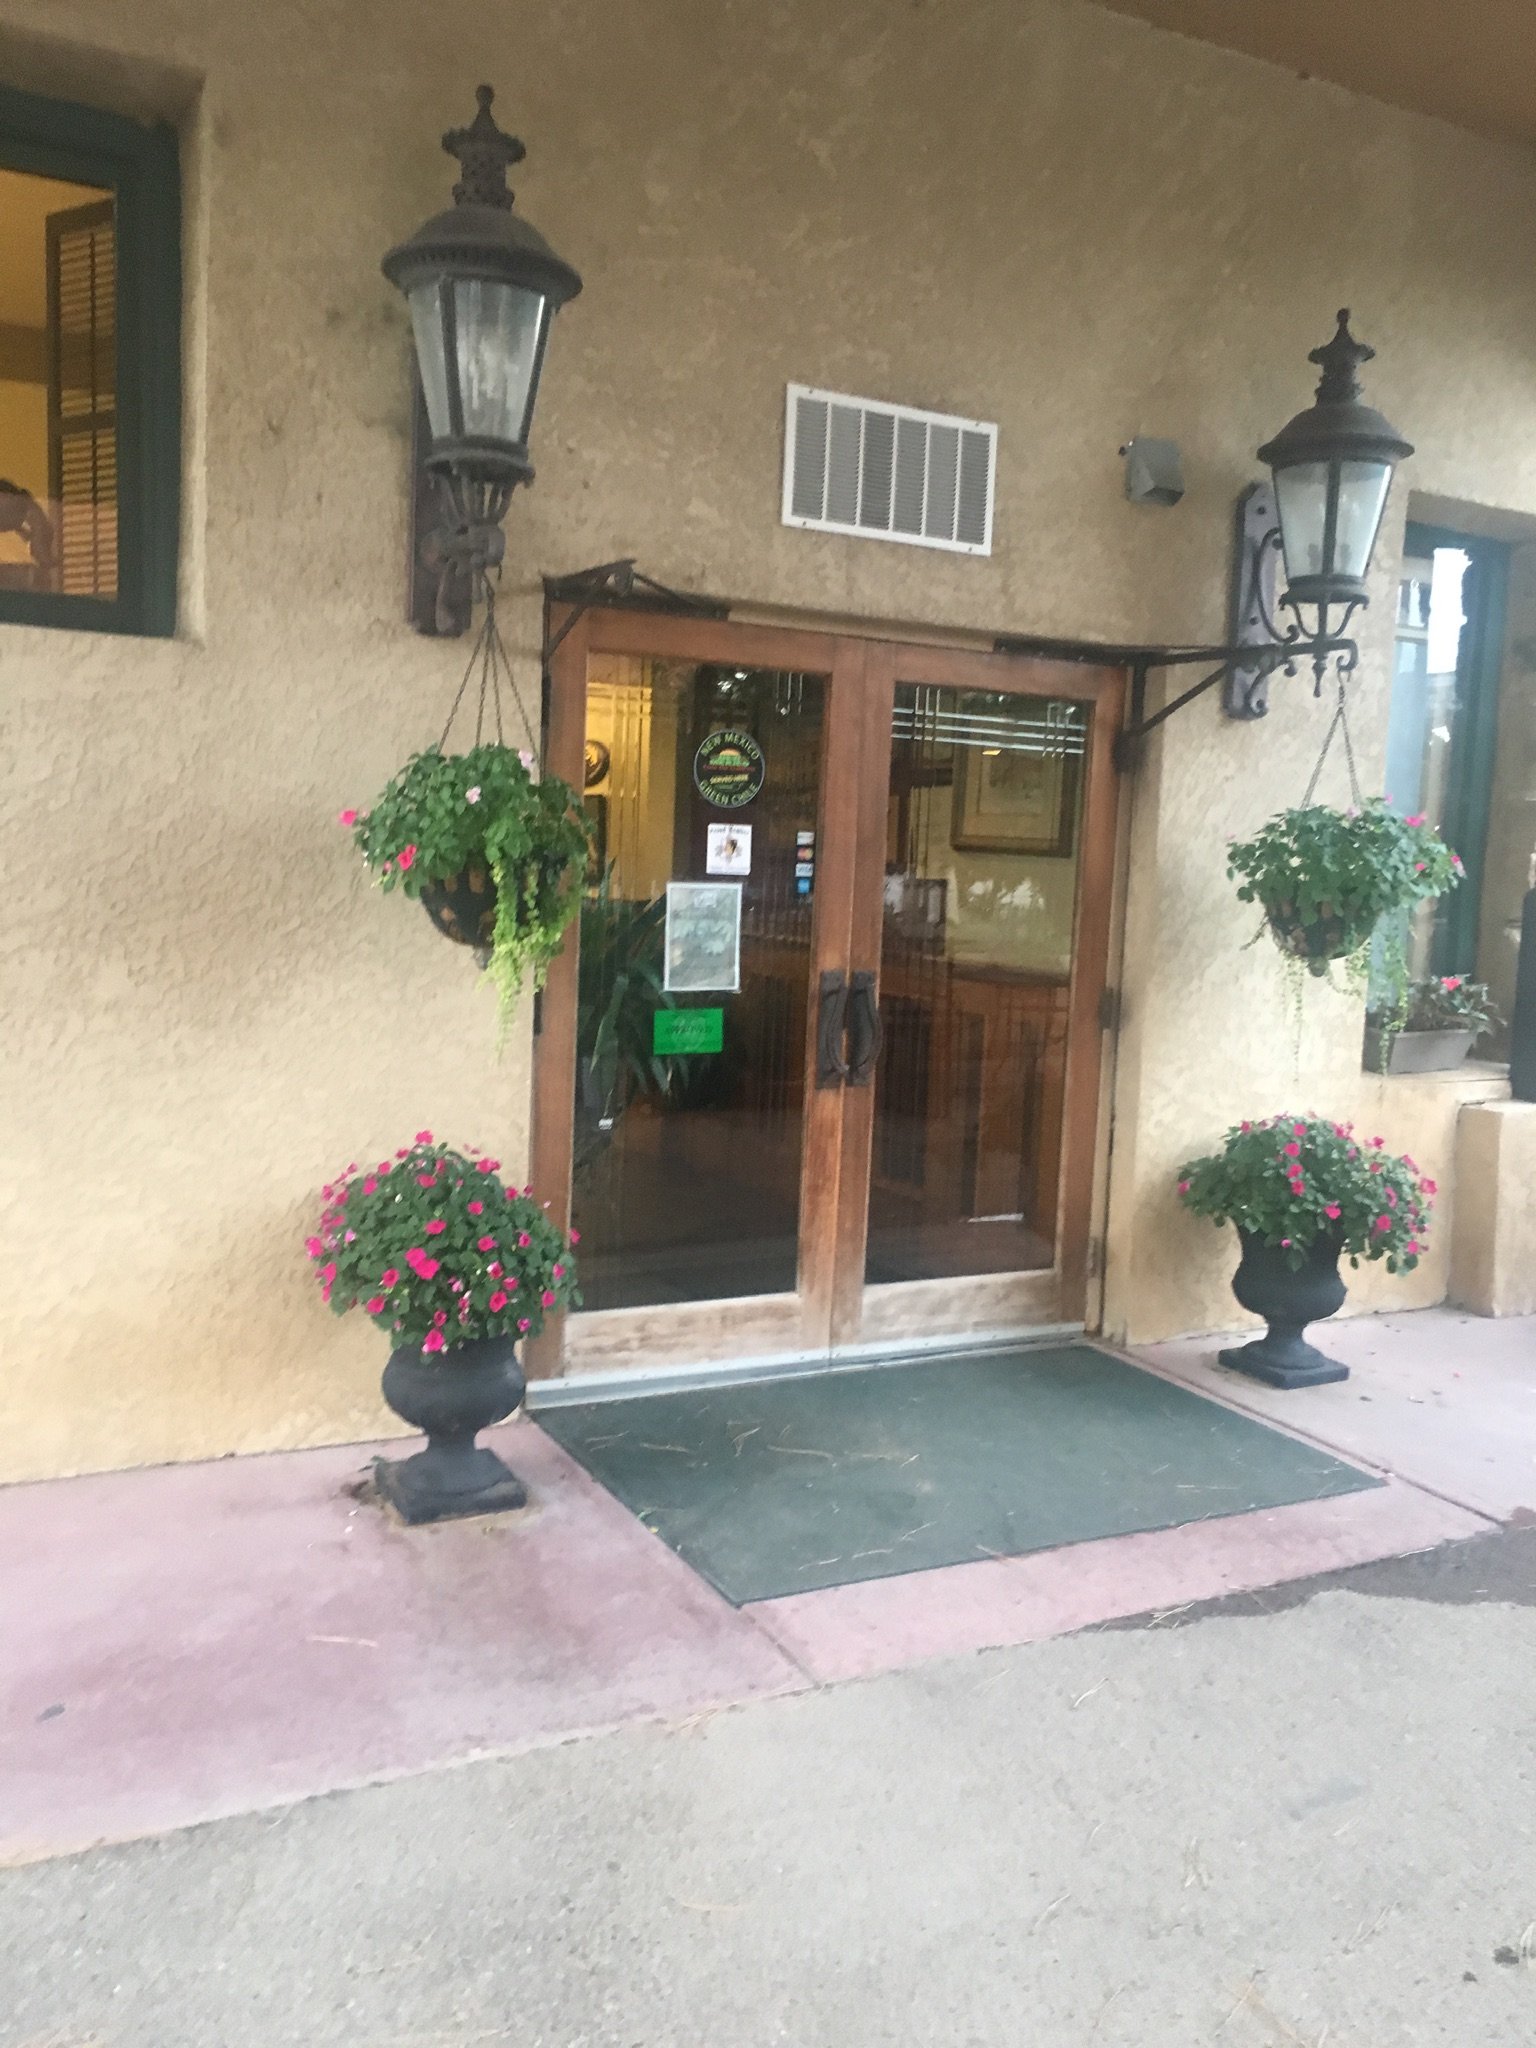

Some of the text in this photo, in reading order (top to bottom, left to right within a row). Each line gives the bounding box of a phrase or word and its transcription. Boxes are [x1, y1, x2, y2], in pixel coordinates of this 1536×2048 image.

[700, 732, 760, 760] NEW MEXICO
[699, 779, 759, 805] GREEN CHILE
